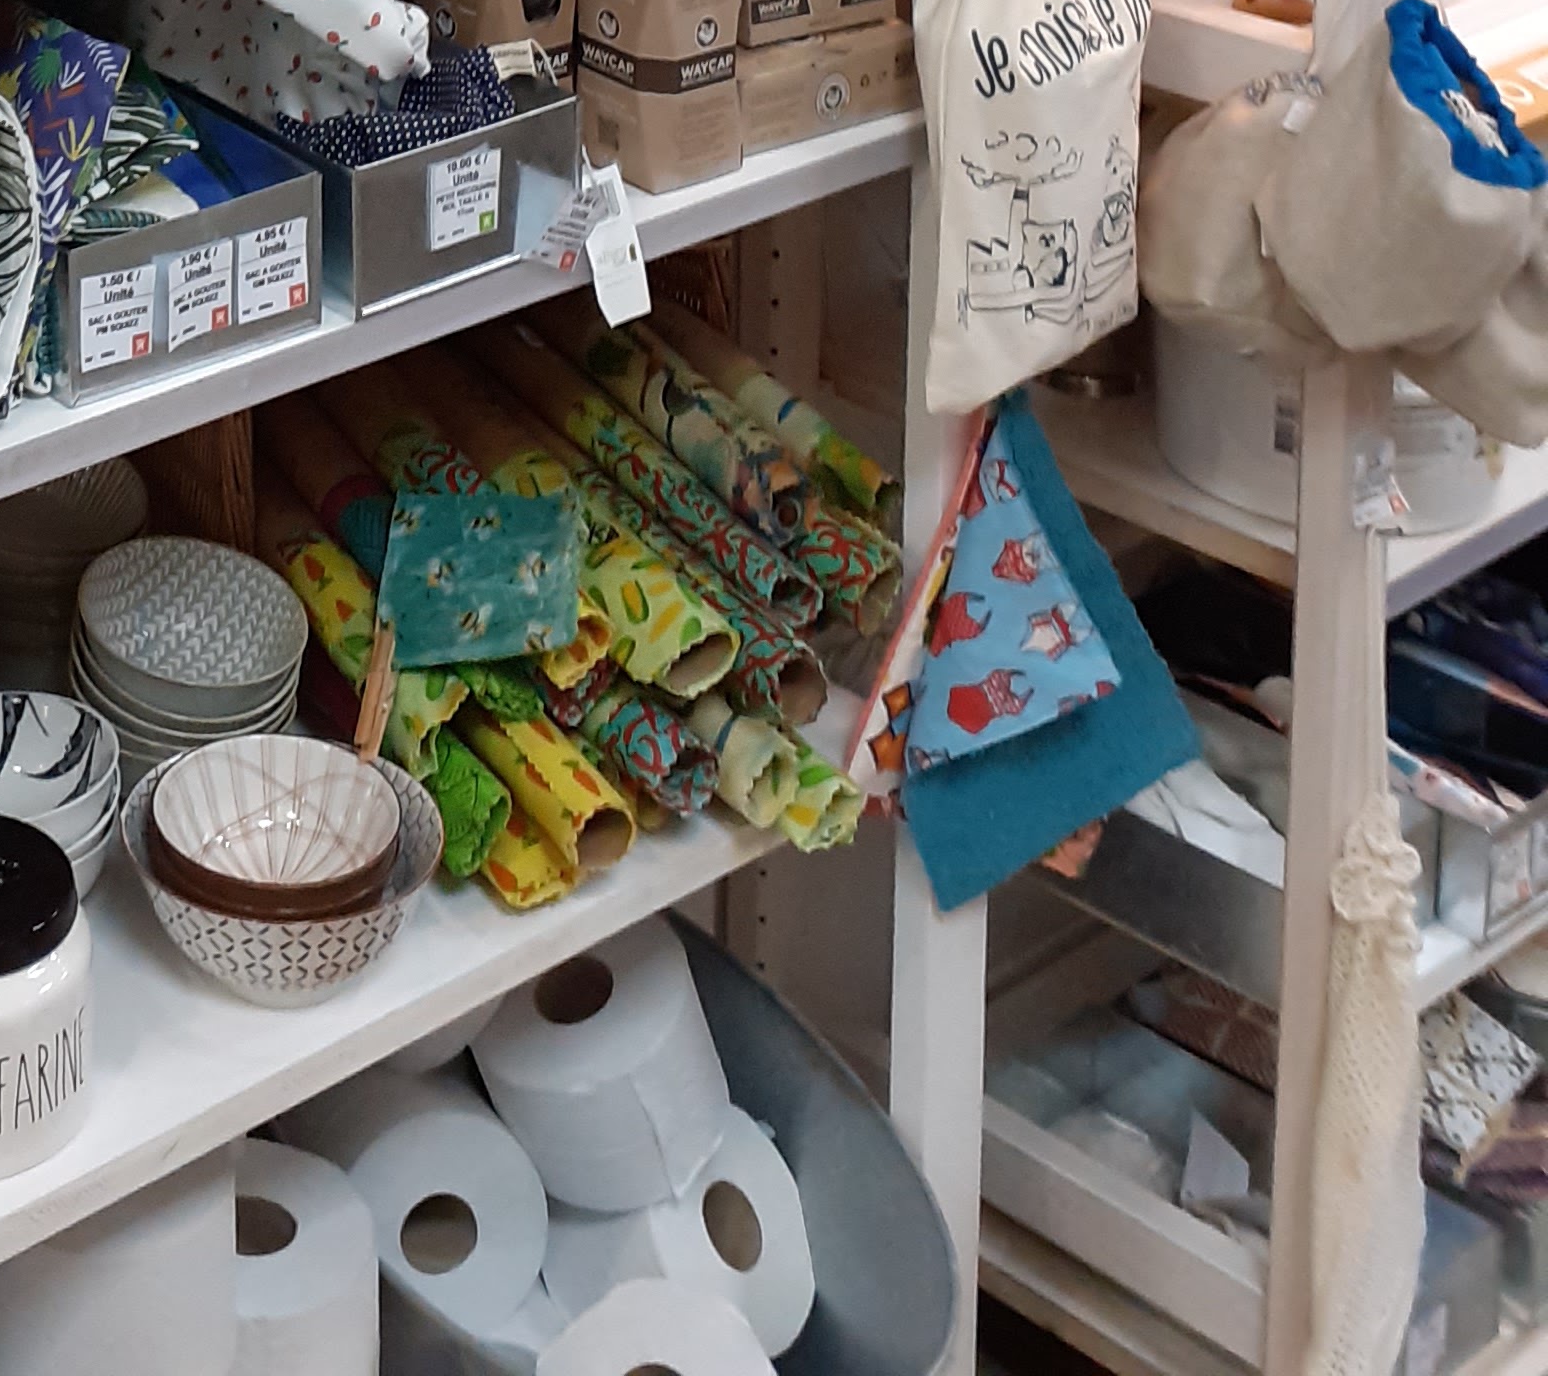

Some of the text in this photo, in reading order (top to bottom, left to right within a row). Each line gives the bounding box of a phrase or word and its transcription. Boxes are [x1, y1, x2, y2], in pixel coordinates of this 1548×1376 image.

[582, 42, 635, 75] WAYCAP
[680, 52, 733, 80] WAYCAP
[973, 27, 1015, 100] Je
[453, 170, 479, 187] Unité
[259, 240, 287, 258] Unité
[184, 264, 212, 282] Unité
[104, 287, 134, 304] Unité
[113, 305, 148, 321] GOUTER
